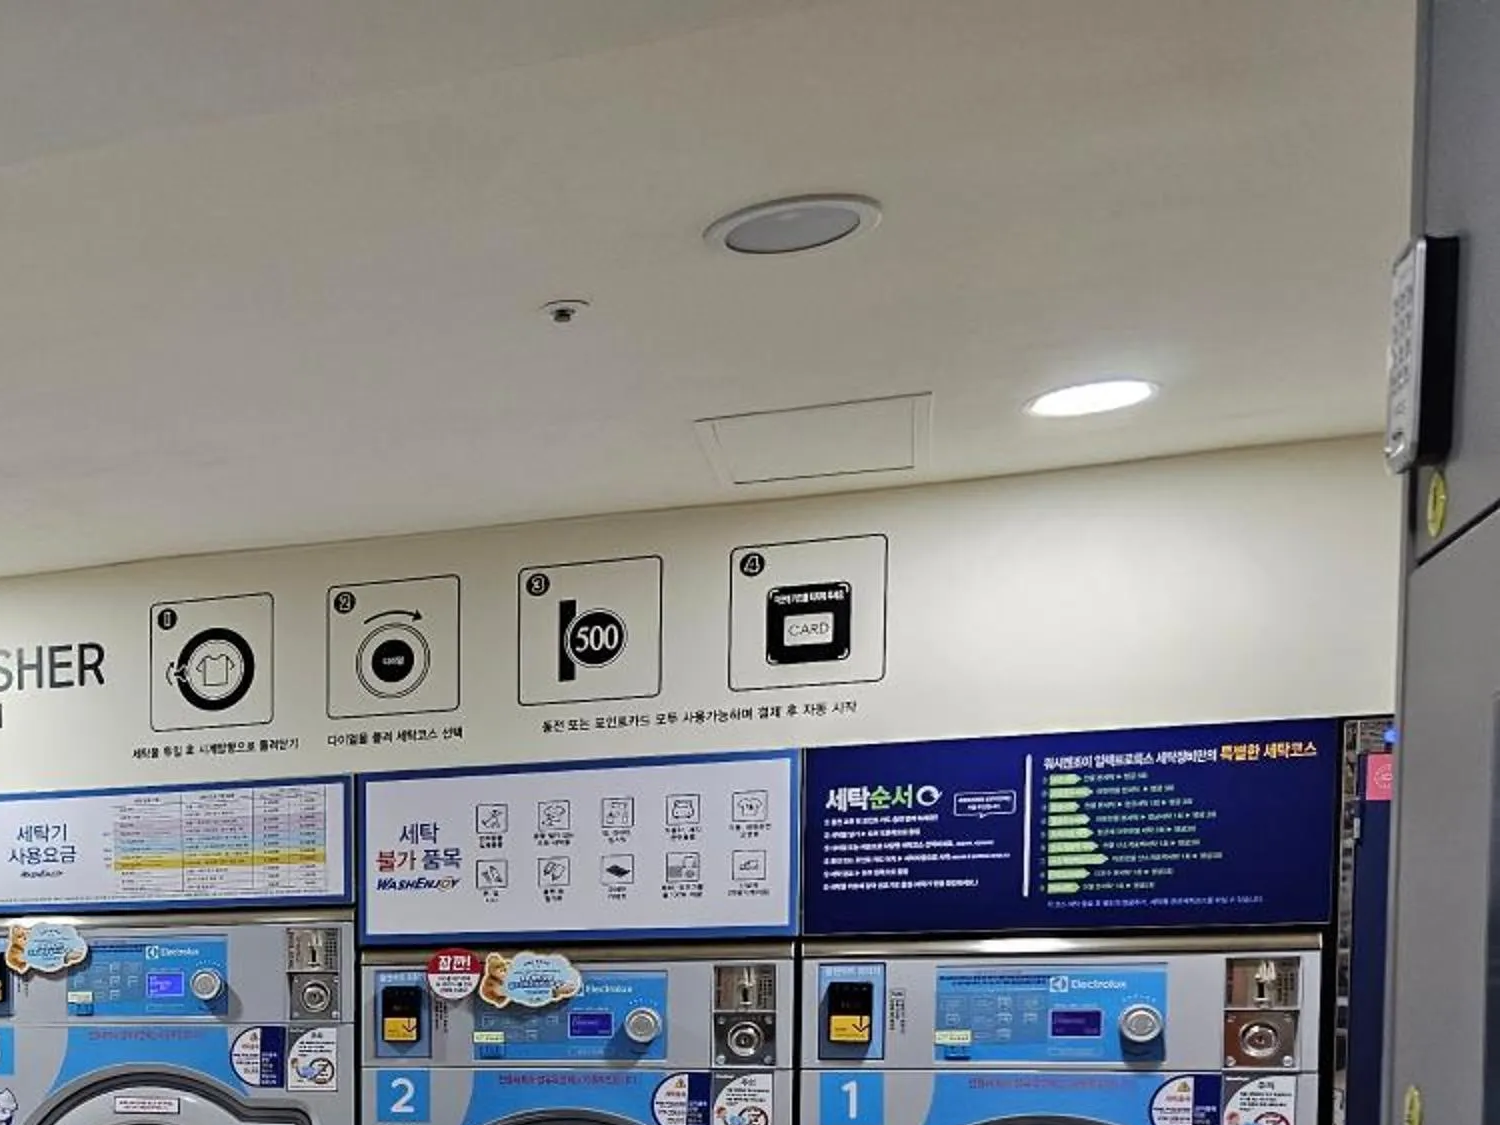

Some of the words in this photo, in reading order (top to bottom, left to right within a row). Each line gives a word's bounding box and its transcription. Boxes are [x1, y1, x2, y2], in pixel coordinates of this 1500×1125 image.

[575, 625, 618, 650] 500
[788, 621, 829, 637] CARD
[568, 718, 590, 731] 또는
[683, 707, 753, 724] 사용가능하며
[803, 702, 827, 716] 자동
[1220, 743, 1259, 761] 특별한
[1264, 741, 1317, 759] 세탁코스
[826, 784, 913, 812] 세탁순서
[16, 822, 68, 844] 세탁기
[399, 823, 439, 845] 세탁
[7, 845, 76, 867] 사용요금
[376, 849, 416, 873] 불가
[422, 846, 463, 871] 품목
[1071, 979, 1127, 990] Electrolux
[390, 1078, 416, 1112] 2
[841, 1081, 859, 1119] 1
